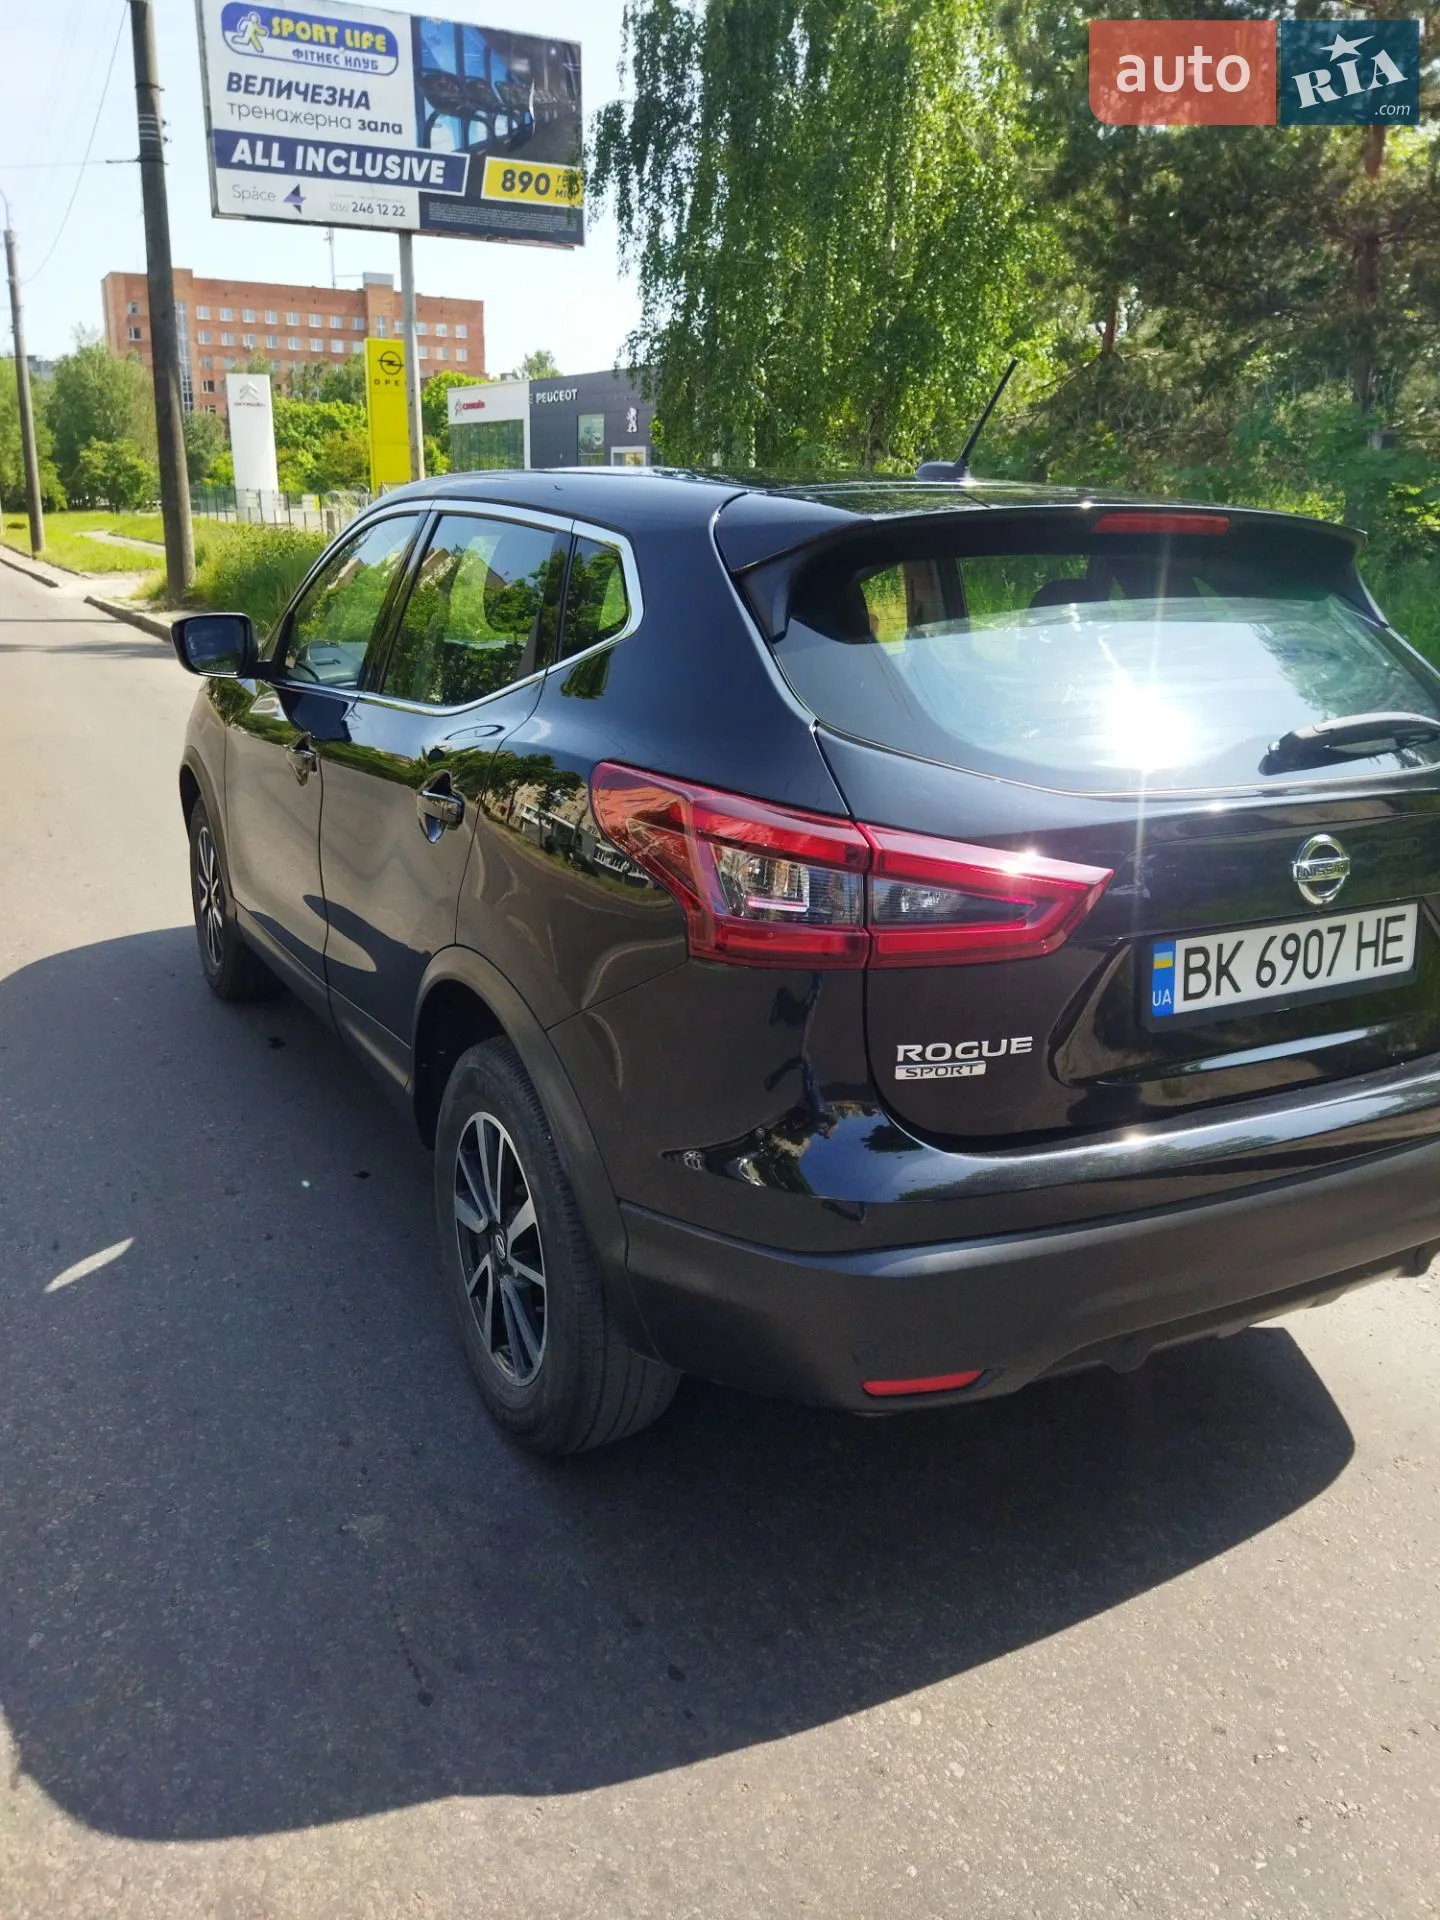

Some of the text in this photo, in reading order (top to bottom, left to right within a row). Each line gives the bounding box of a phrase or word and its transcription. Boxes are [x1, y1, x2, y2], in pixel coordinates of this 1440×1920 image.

[271, 16, 386, 53] SPORT LIFE
[292, 48, 340, 66] ФІТНЕС
[226, 71, 371, 111] ВЕЛИЧЕЗНА
[227, 102, 403, 135] тренажерна зала
[230, 138, 446, 184] ALL INCLUSIVE
[501, 169, 551, 195] 890
[351, 201, 374, 214] 246
[377, 203, 389, 216] 12
[392, 205, 406, 217] 22
[374, 379, 407, 387] OPE
[536, 389, 578, 404] PEUGEOT
[1183, 914, 1406, 1001] BK 6907 HE
[1152, 988, 1172, 1007] UA
[896, 1036, 1033, 1062] ROGUE
[905, 1064, 978, 1078] SPORT
